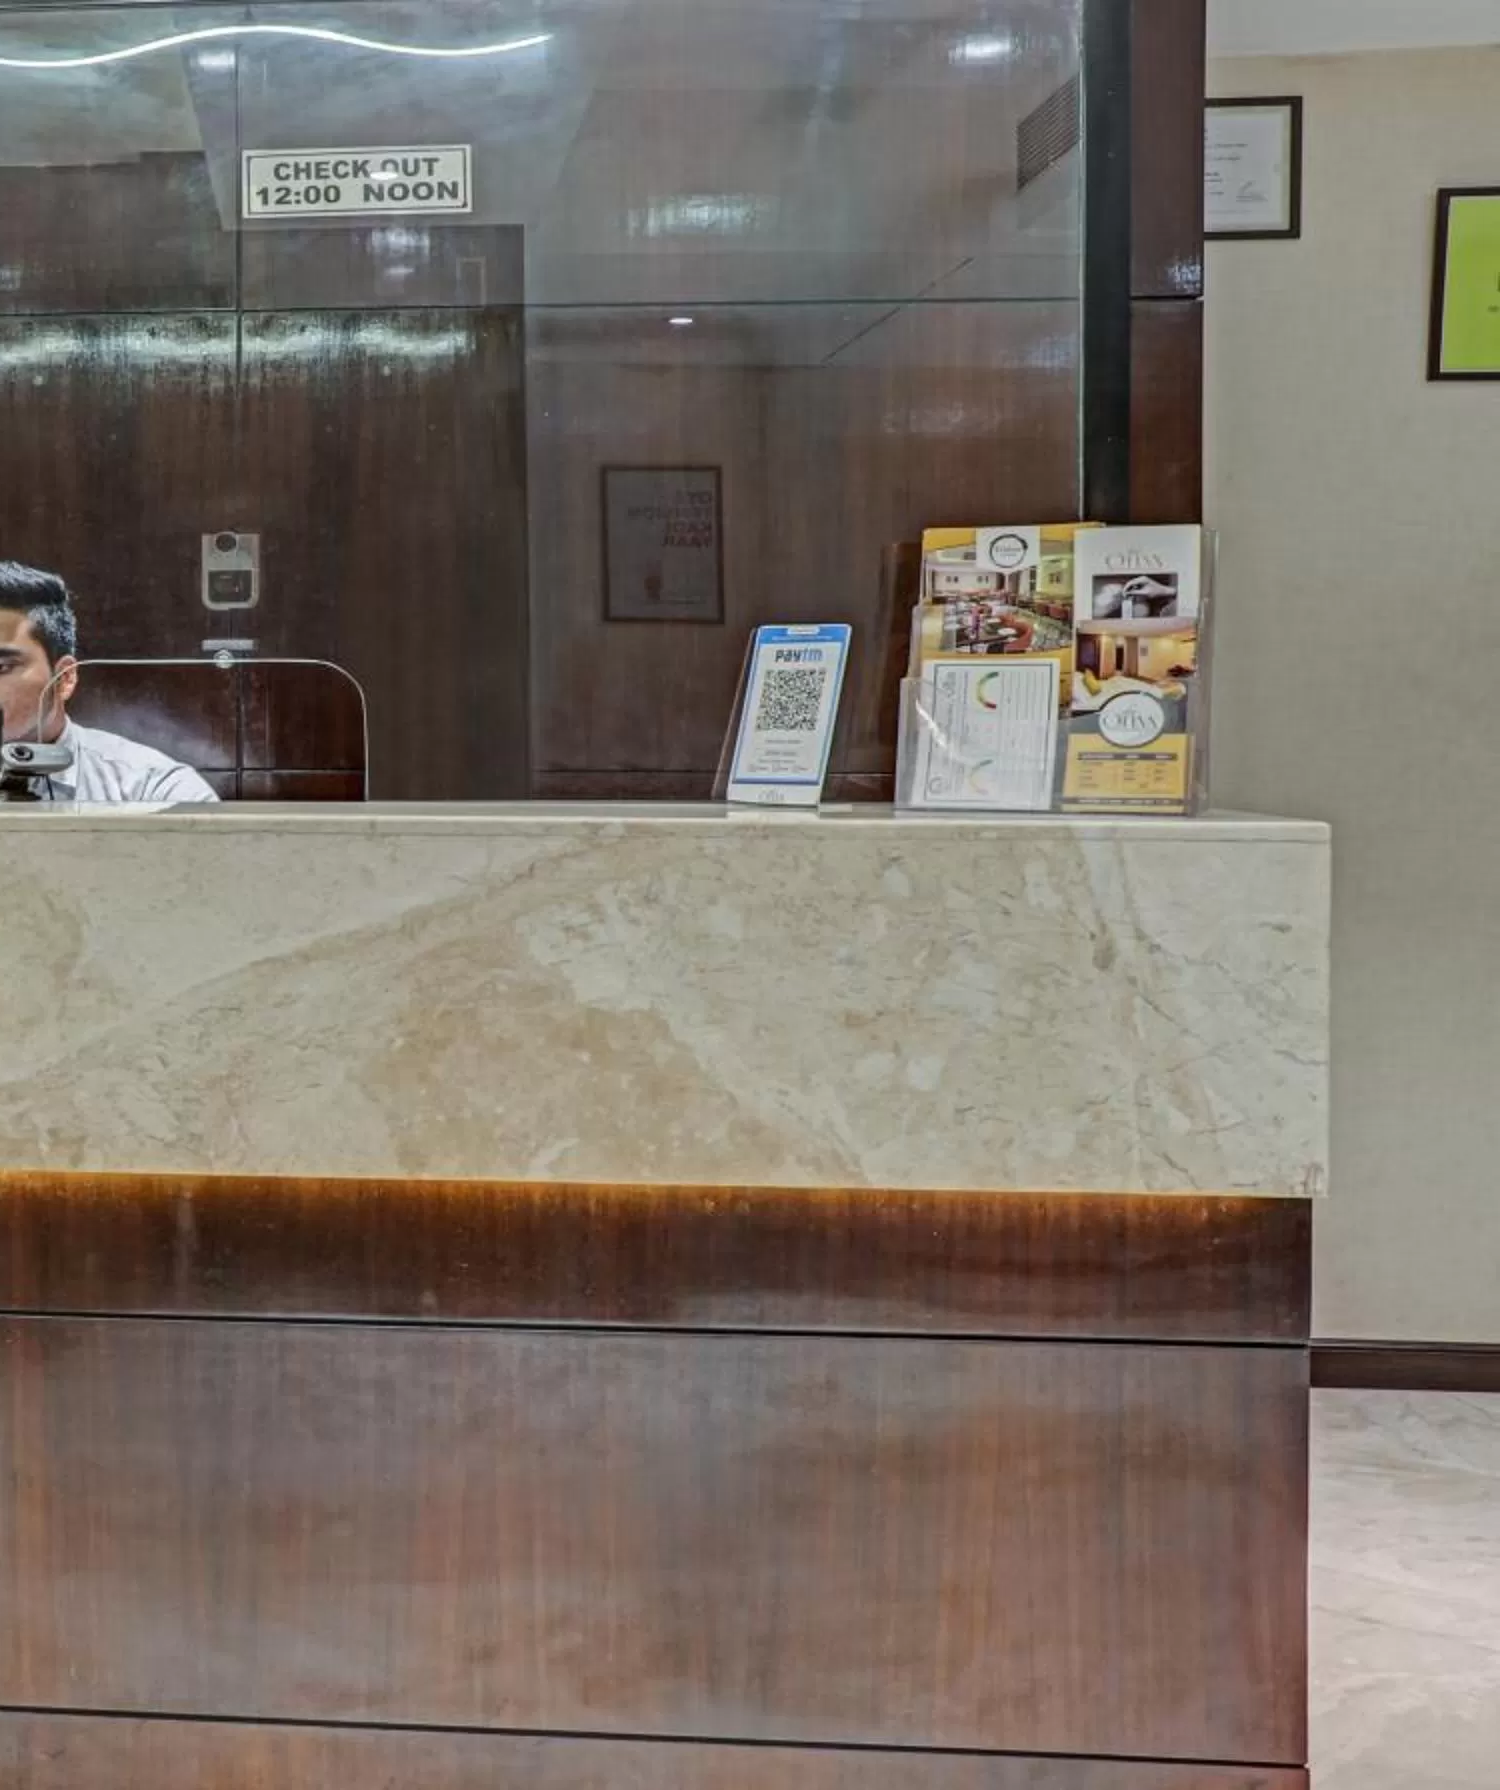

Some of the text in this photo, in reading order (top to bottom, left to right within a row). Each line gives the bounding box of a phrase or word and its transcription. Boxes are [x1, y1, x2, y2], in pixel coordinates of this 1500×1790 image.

[273, 156, 440, 182] CHECK OUT
[256, 181, 459, 207] 12:00 NOON
